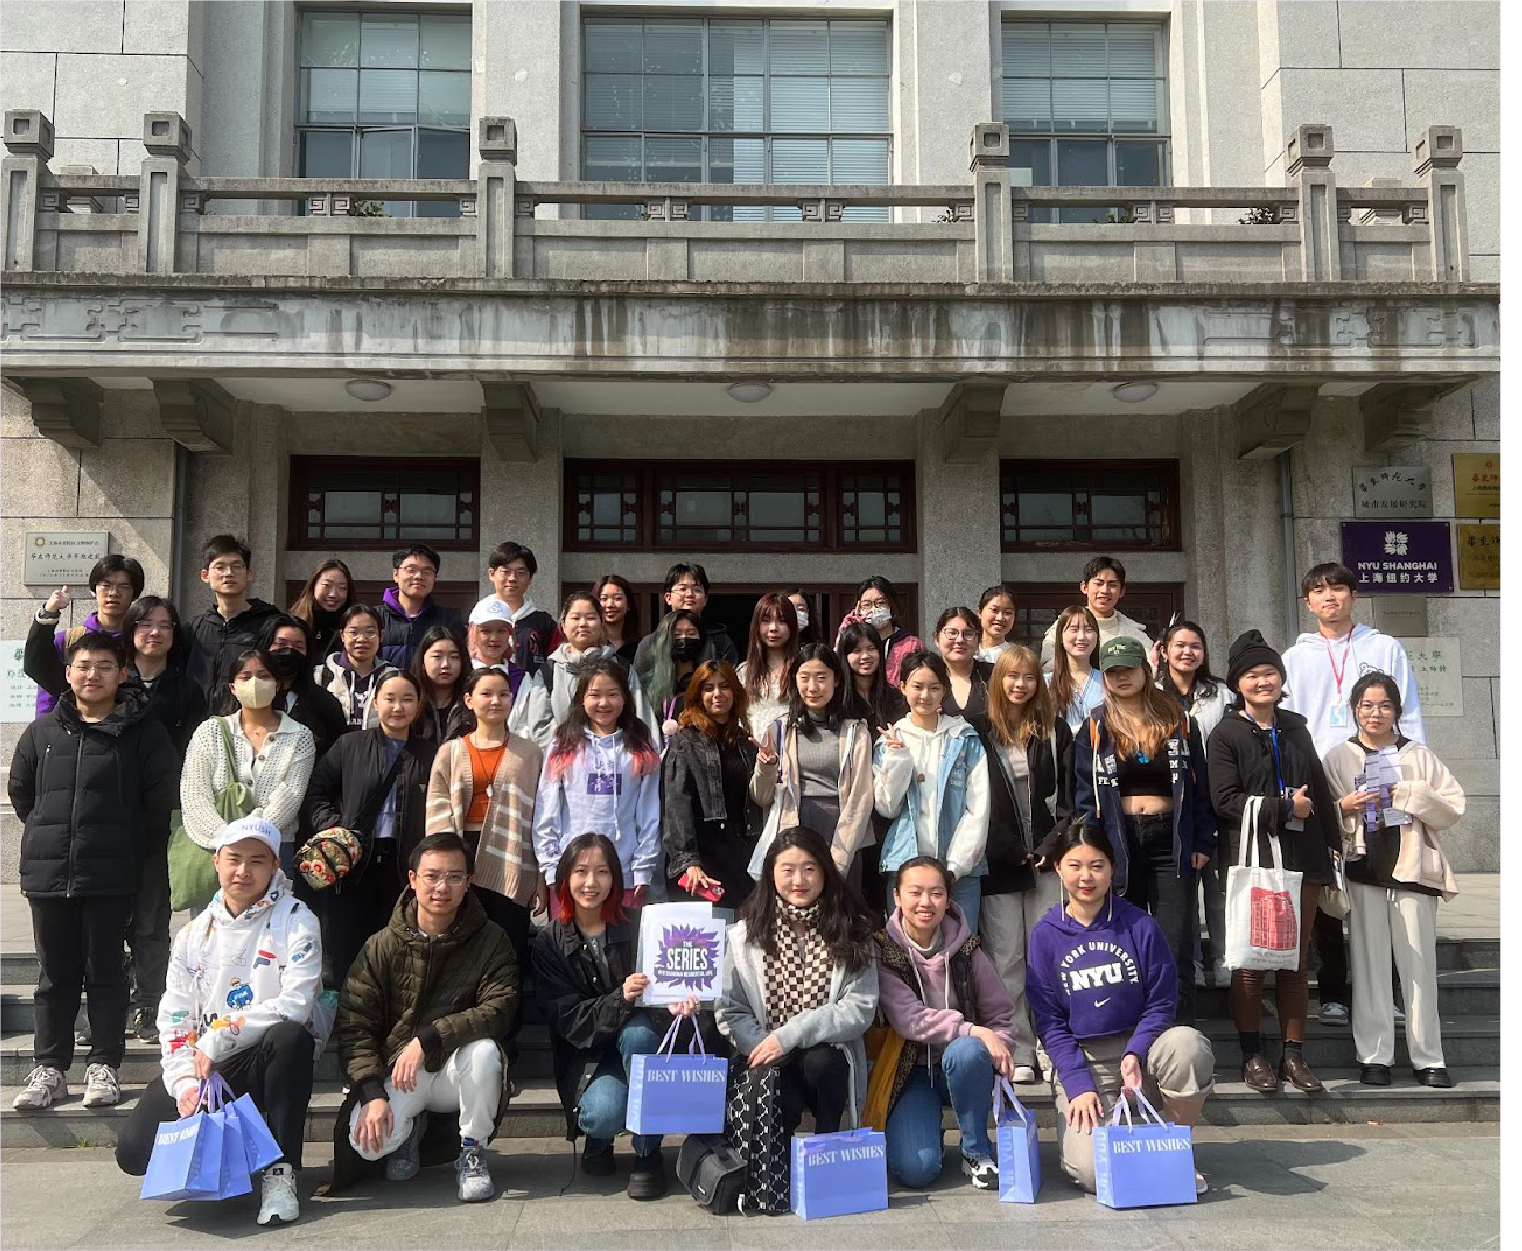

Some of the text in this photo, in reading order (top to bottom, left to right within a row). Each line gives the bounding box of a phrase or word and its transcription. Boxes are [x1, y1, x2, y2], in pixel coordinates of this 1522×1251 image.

[1358, 562, 1437, 571] NYU SHANGHAI
[1358, 572, 1438, 584] 上海纽约大学
[667, 948, 708, 971] SERIES
[1061, 944, 1087, 968] YORK
[1088, 941, 1139, 985] UNIVERSITY
[1069, 962, 1124, 991] NYU
[648, 1069, 726, 1082] BEST WISHES
[808, 1144, 884, 1167] BEST WISHES
[1113, 1137, 1190, 1154] BEST WISHES
